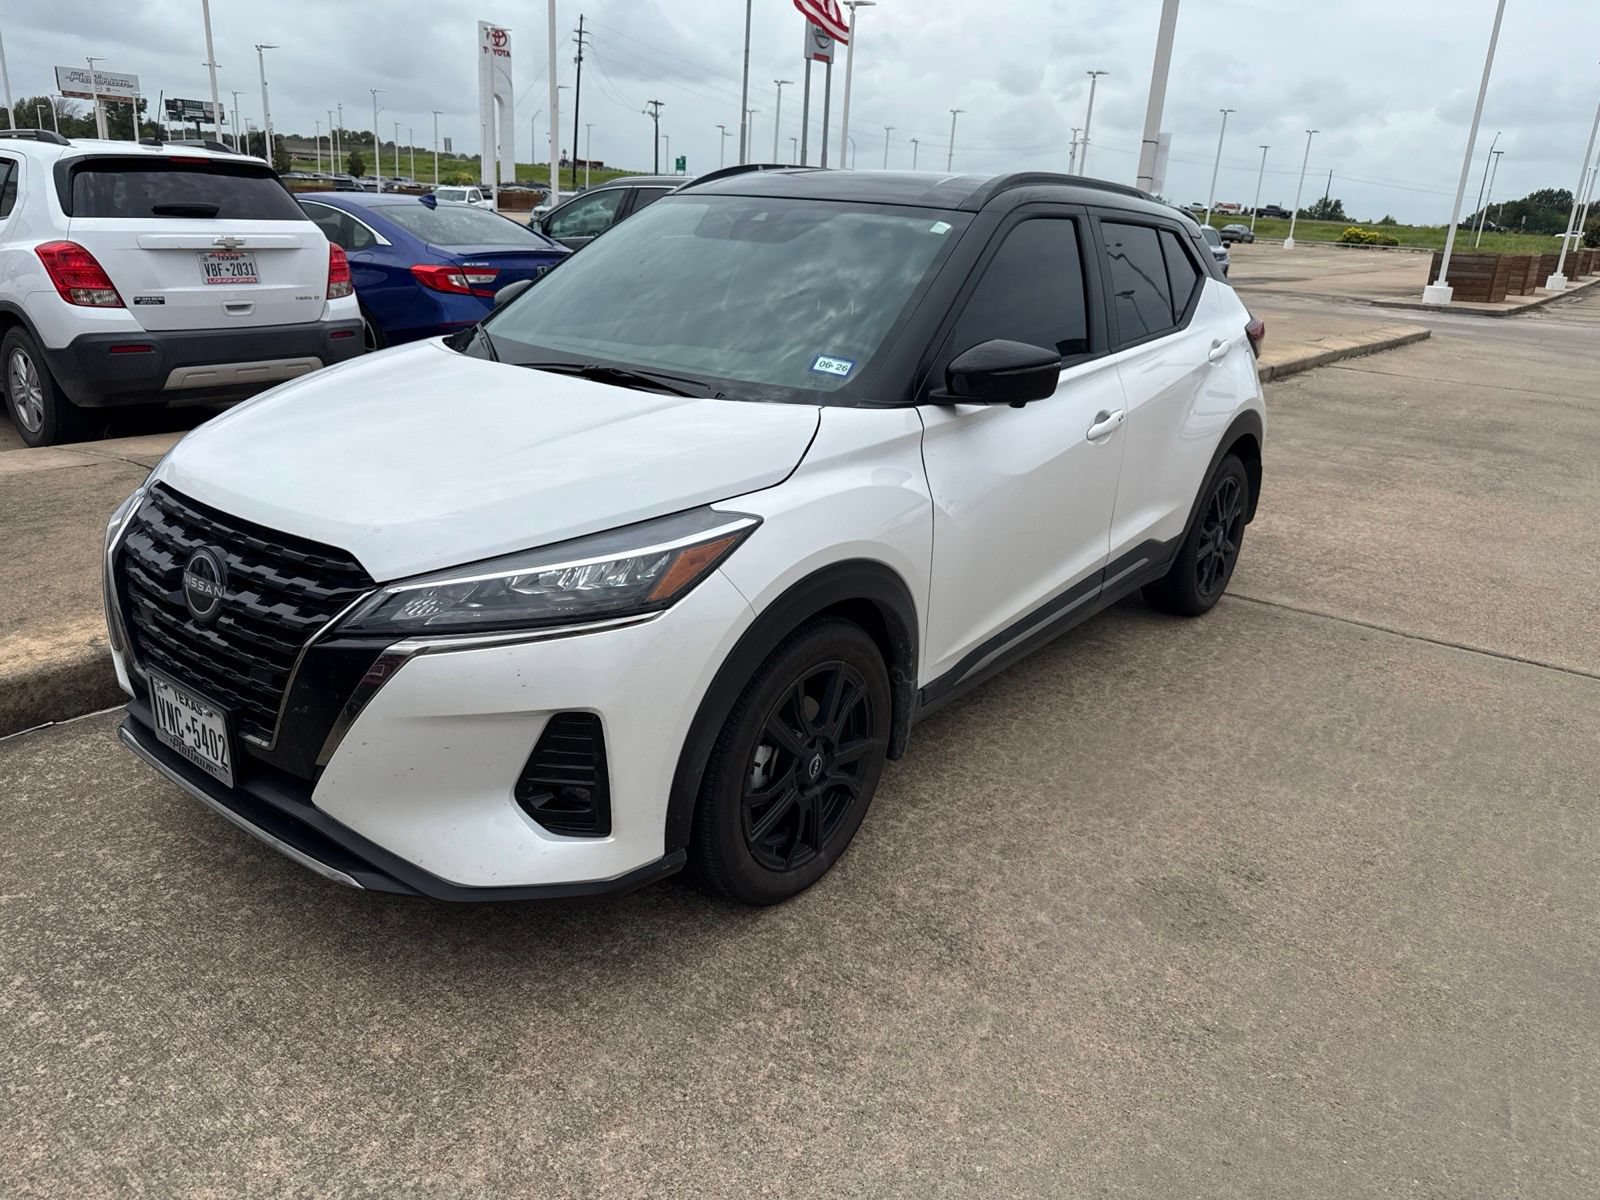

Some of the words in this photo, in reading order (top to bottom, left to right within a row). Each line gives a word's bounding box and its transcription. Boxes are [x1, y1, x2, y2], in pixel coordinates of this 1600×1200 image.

[482, 46, 511, 58] TYOTA
[183, 571, 223, 598] NISSAN
[174, 690, 203, 716] TEXAS
[172, 737, 216, 774] Platinum
